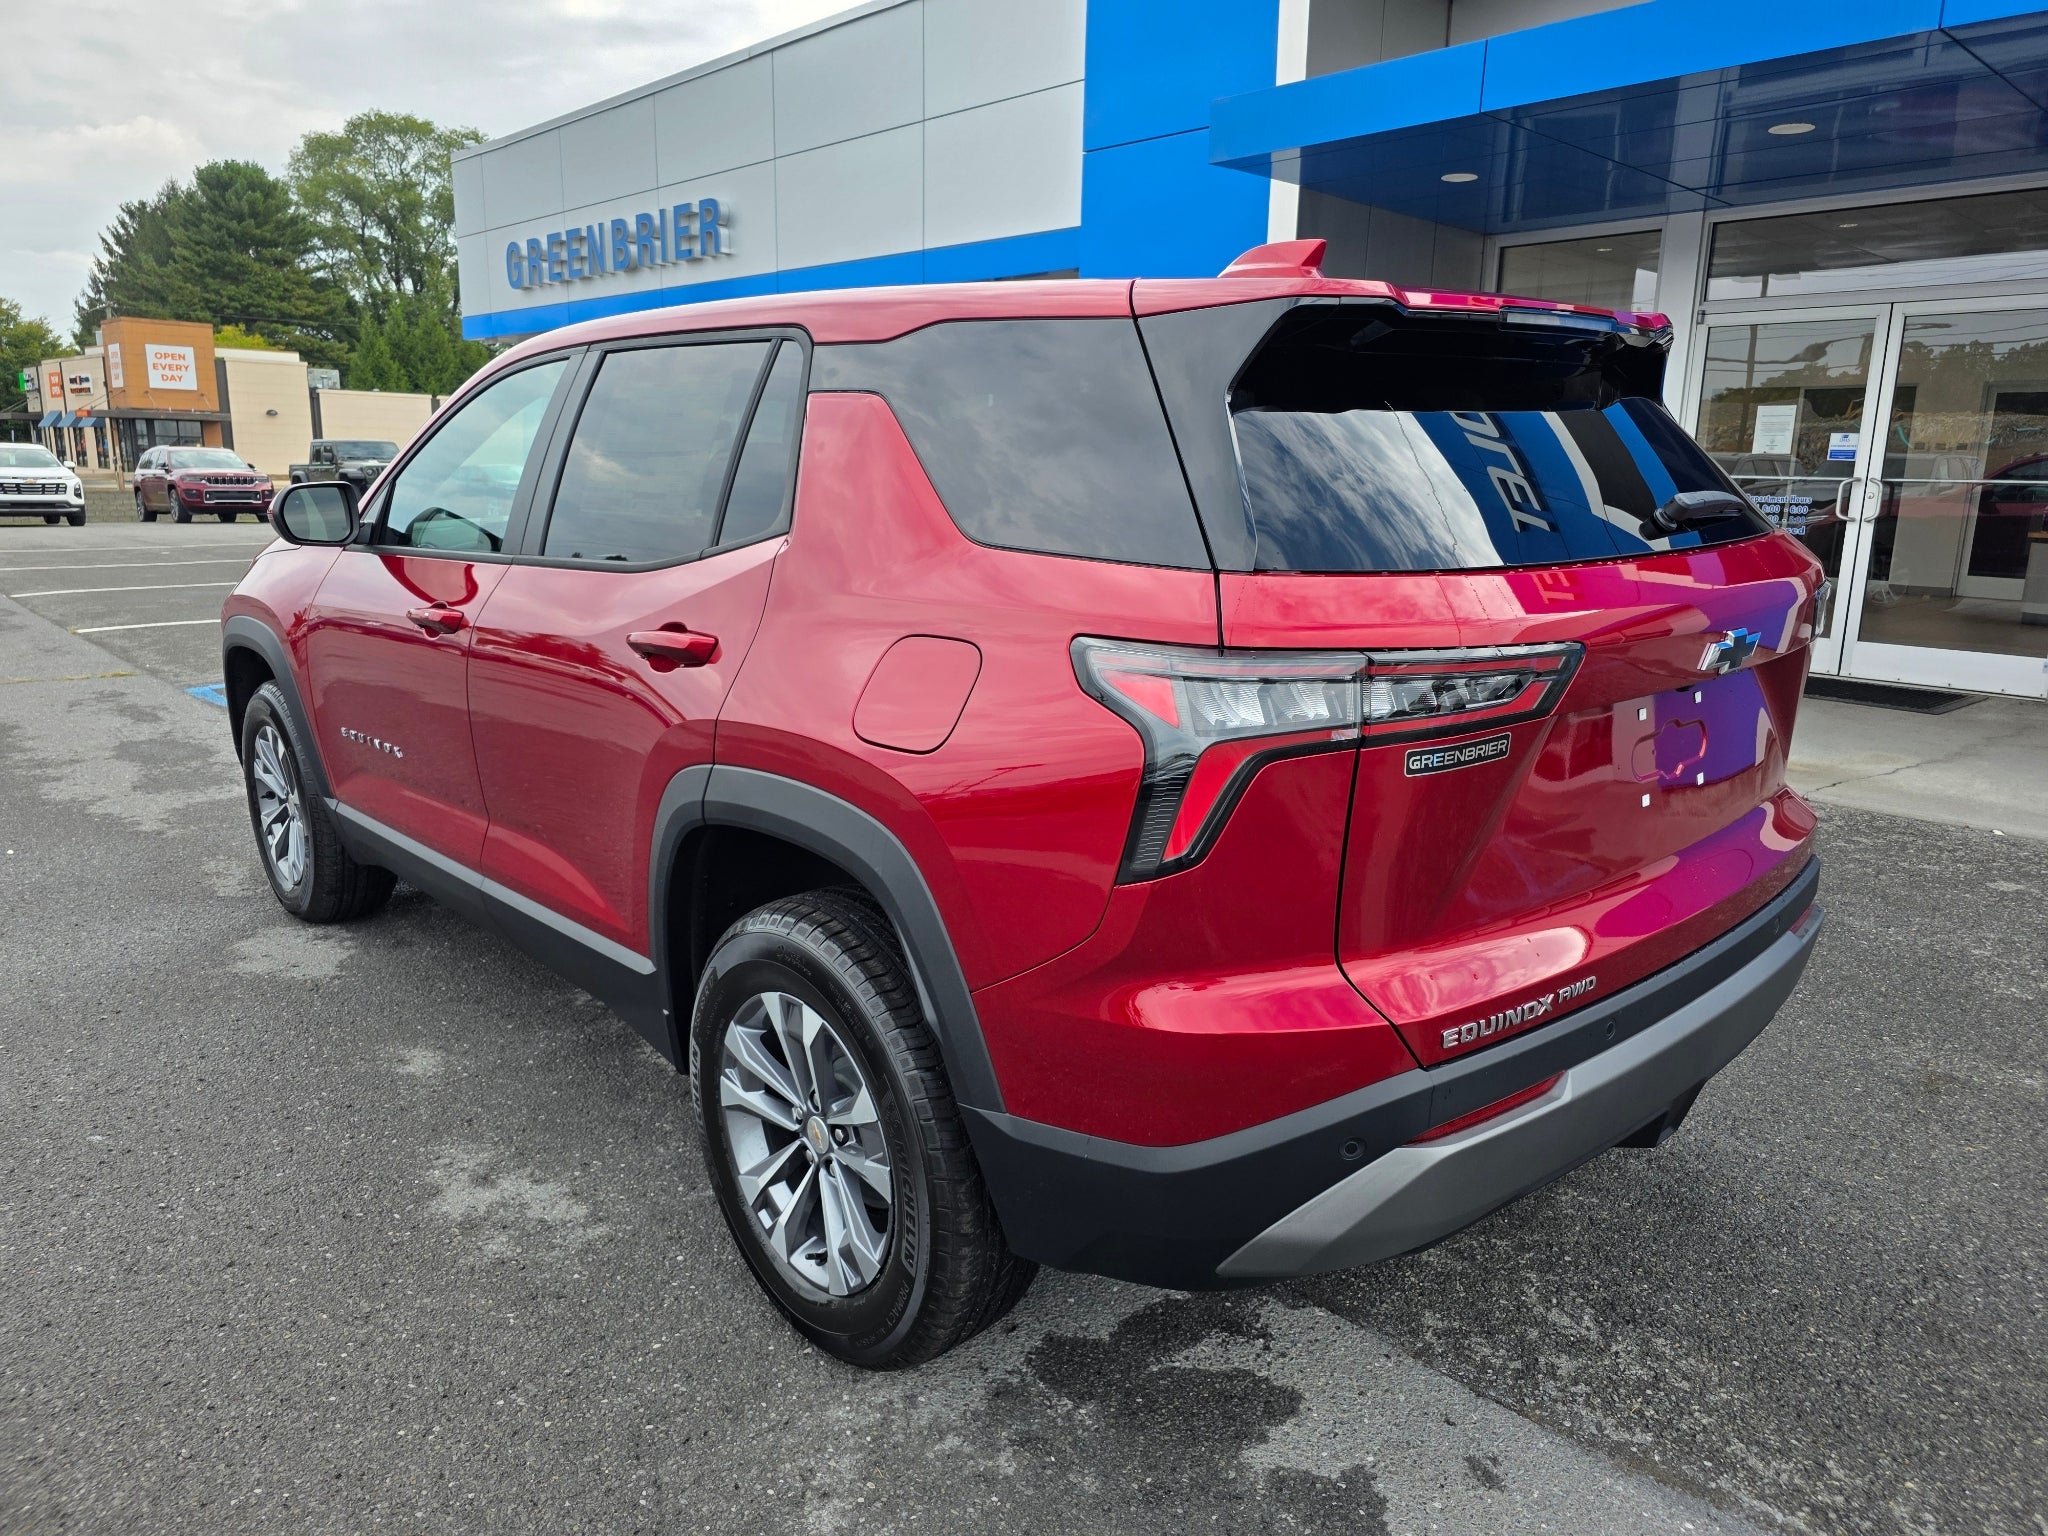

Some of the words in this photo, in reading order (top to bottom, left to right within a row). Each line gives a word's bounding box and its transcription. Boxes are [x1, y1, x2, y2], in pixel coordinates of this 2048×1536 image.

[506, 198, 724, 290] GREENBRIER
[154, 351, 186, 361] OPEN
[152, 362, 190, 372] EVERY
[161, 374, 183, 383] DAY
[1790, 495, 1813, 504] Hours
[1408, 740, 1508, 770] GREENBRIER
[1441, 993, 1555, 1049] EQUINOX
[1558, 975, 1597, 1003] AWD
